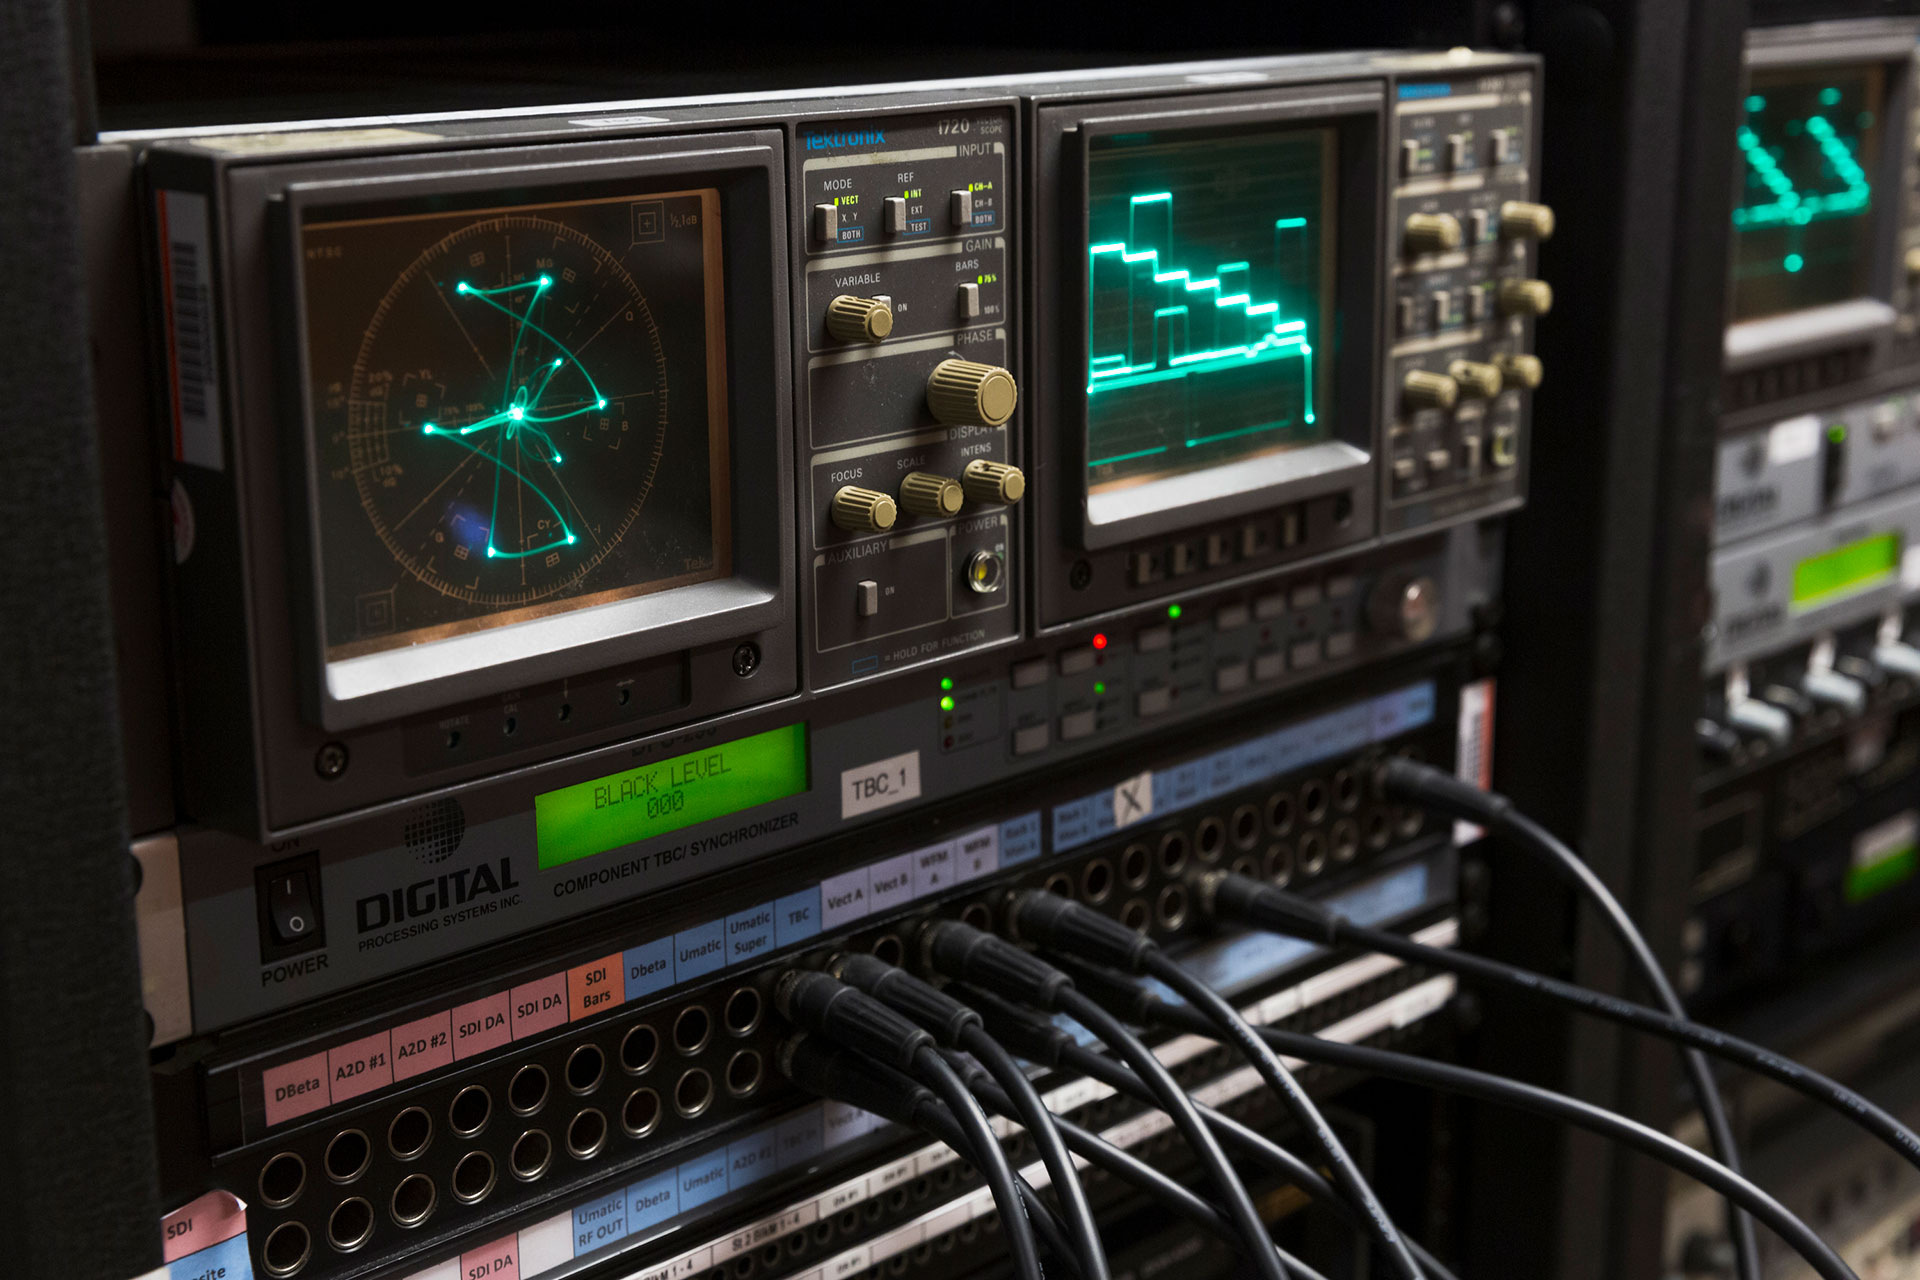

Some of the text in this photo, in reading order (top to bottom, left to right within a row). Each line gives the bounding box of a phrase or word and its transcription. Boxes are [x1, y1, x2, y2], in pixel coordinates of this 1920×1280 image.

[938, 118, 970, 135] 1720
[980, 125, 1002, 134] SCOPE
[803, 127, 886, 151] Tektronix
[959, 142, 991, 157] INPUT
[824, 178, 852, 191] MODE
[897, 172, 914, 183] REF
[974, 181, 993, 191] CH-A
[841, 195, 859, 205] VECT
[910, 188, 922, 198] INT
[911, 205, 923, 215] EXT
[975, 213, 993, 224] BOTH
[842, 229, 861, 240] BOTH
[911, 221, 927, 232] TEST
[965, 237, 992, 253] GAIN
[955, 259, 979, 272] BARS
[835, 272, 881, 288] VARIABLE
[897, 303, 908, 313] ON
[957, 330, 993, 346] PHASE
[960, 442, 992, 457] INTENS
[896, 455, 926, 470] SCALE
[831, 467, 863, 483] FOCUS
[537, 519, 551, 531] CY
[958, 515, 998, 535] POWER
[827, 539, 888, 566] AUXILIARY
[885, 586, 895, 596] ON
[893, 646, 918, 661] HOLD
[920, 641, 939, 654] FOR
[942, 629, 985, 648] FUNCTION
[594, 753, 732, 810] BLACK LEVEL
[852, 769, 907, 801] TBC_1
[646, 791, 684, 819] 000
[554, 812, 799, 898] COMPONENT TBC/ SYNCHRONIZER
[356, 857, 519, 934] DIGITAL
[827, 888, 863, 909] Vect A
[358, 919, 438, 952] PROCESSING
[443, 901, 497, 926] SYSTEMS
[730, 911, 772, 935] Umatic
[788, 909, 810, 927] TBC
[680, 940, 722, 963] Umatic
[734, 934, 768, 957] Super
[261, 954, 329, 987] POWER
[586, 968, 606, 986] SDI
[631, 957, 666, 980] Dbeta
[517, 993, 562, 1018] SDI DA
[583, 989, 611, 1009] Bars
[459, 1013, 506, 1039] SDI DA
[397, 1031, 448, 1061] A2D #2
[335, 1053, 387, 1082] A2D #1
[274, 1076, 321, 1102] DBeta
[733, 1152, 756, 1170] A2D
[684, 1166, 724, 1192] Umatic
[636, 1190, 671, 1212] Dbeta
[579, 1199, 623, 1225] Umatic
[167, 1218, 193, 1240] SDI
[579, 1218, 623, 1247] RF OUT
[192, 1267, 227, 1280] site
[468, 1255, 514, 1280] SDI DA
